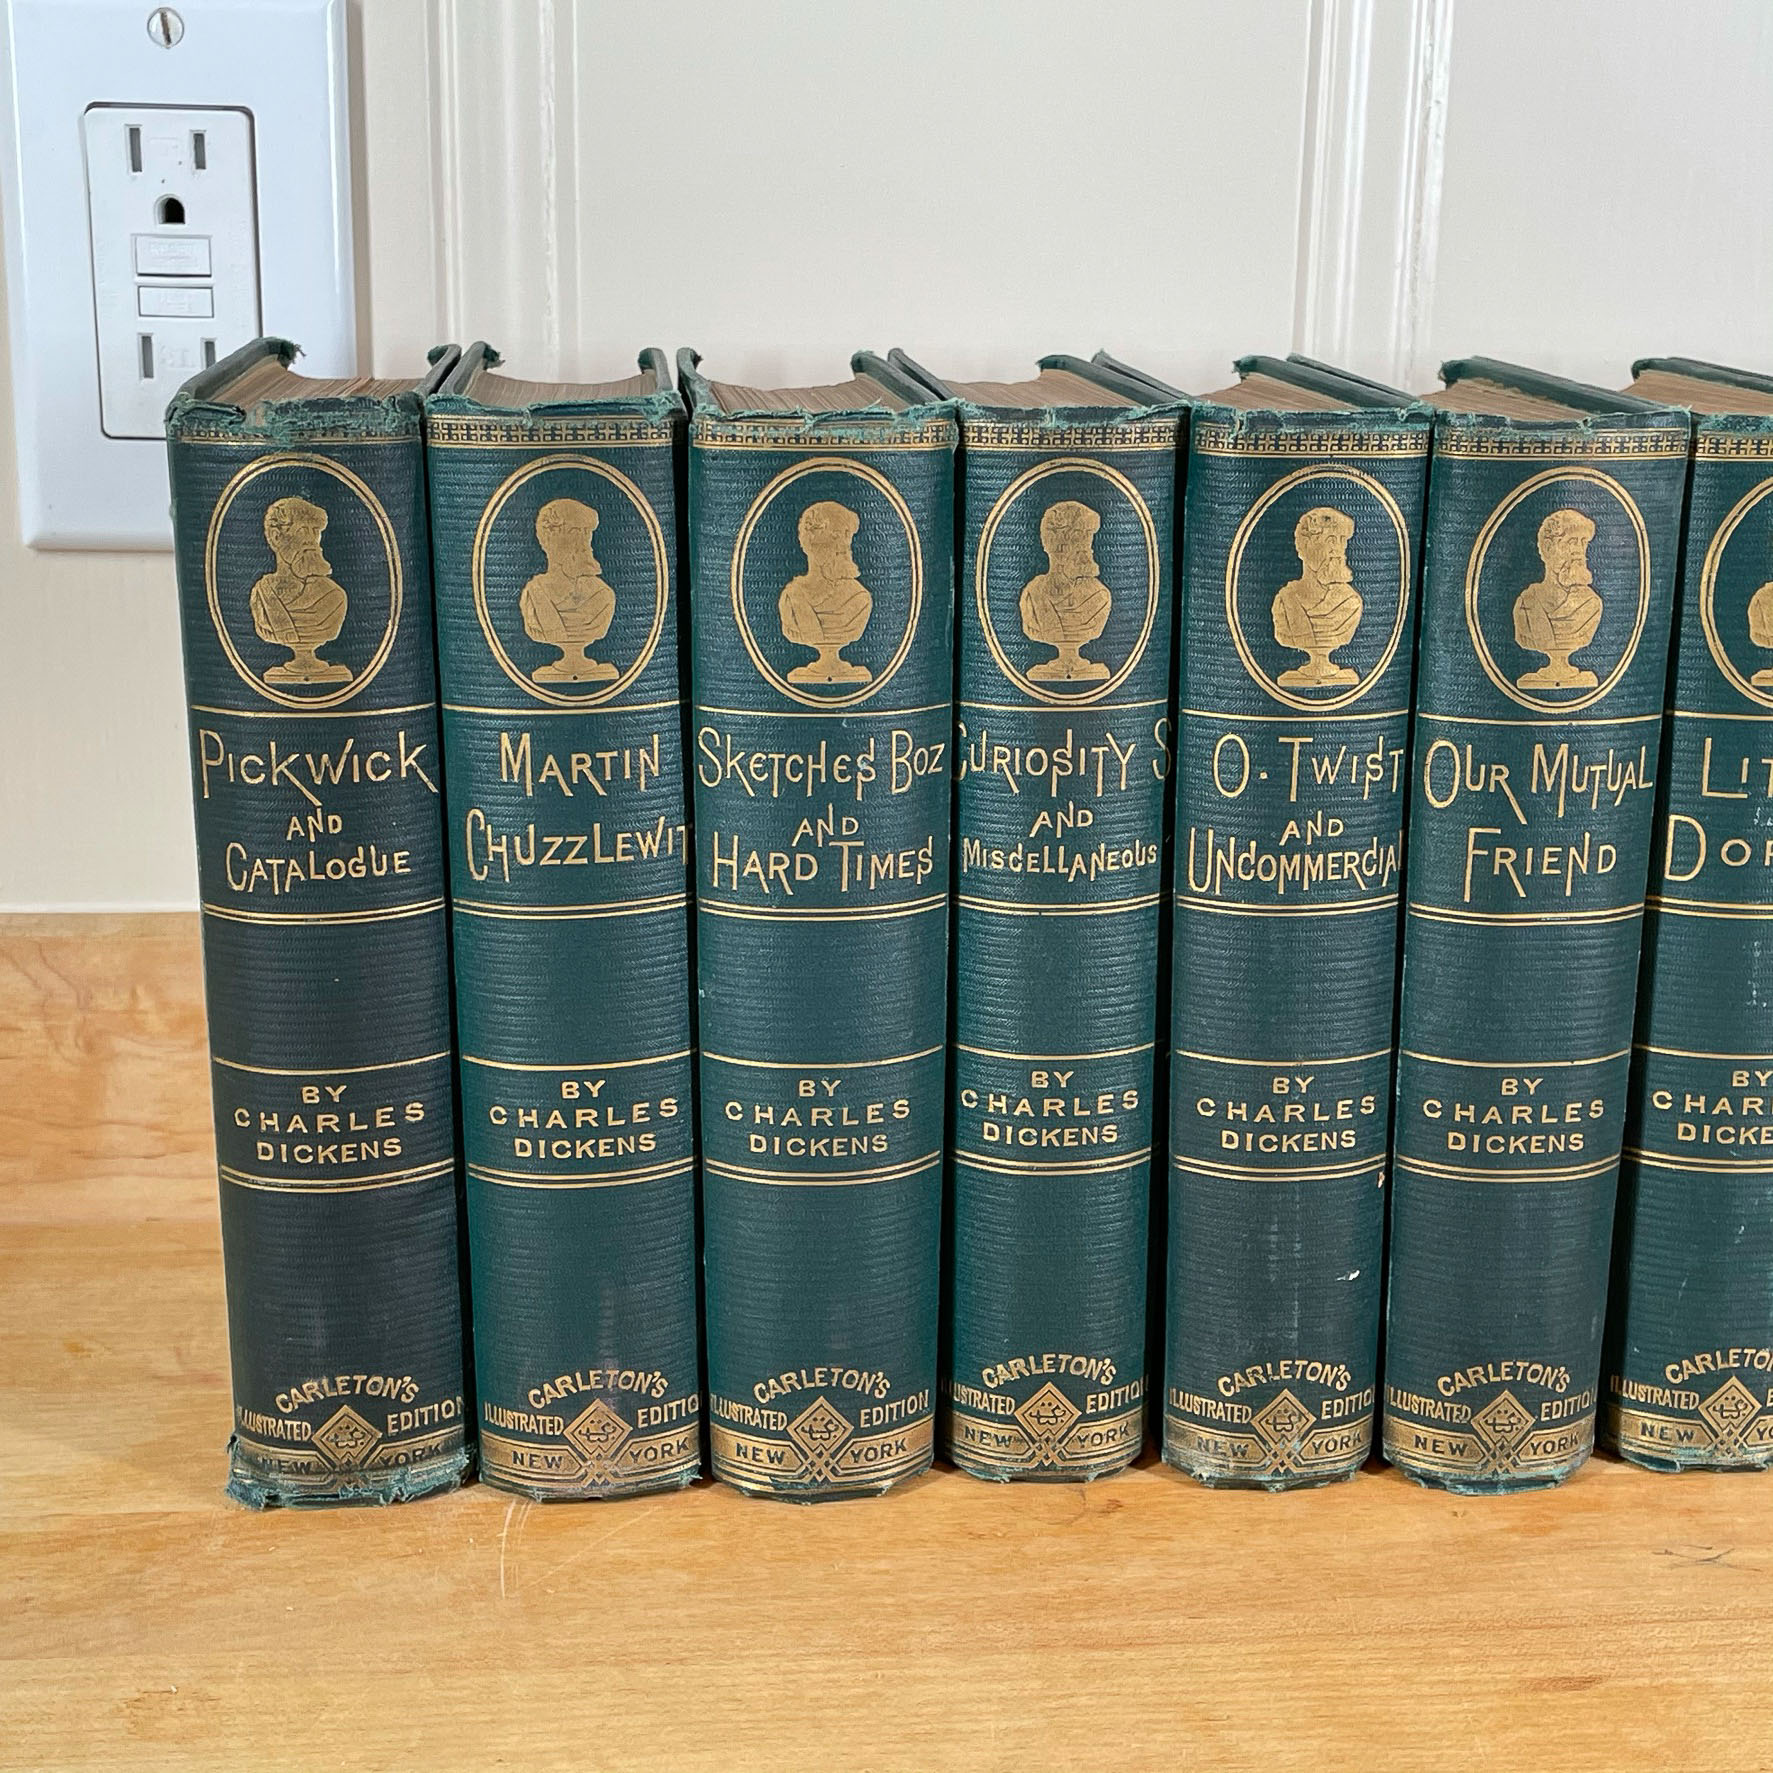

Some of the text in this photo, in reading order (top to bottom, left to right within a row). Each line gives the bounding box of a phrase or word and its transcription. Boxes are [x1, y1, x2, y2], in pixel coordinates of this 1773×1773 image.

[500, 732, 661, 799] MARTIN
[890, 729, 946, 795] BOZ
[1278, 735, 1405, 802] TWIST
[1423, 739, 1654, 824] OUR MUTUAL
[286, 808, 343, 844] AND
[791, 803, 860, 848] AND
[1029, 800, 1094, 838] AND
[1278, 811, 1345, 846] AND
[225, 842, 412, 895] CATALOGUE
[712, 832, 934, 896] HARD TIMES
[961, 838, 1158, 882] MISCELLANEOUS
[1463, 826, 1617, 903] FRIEND
[301, 1085, 348, 1104] BY
[560, 1079, 607, 1100] BY
[798, 1079, 843, 1098] BY
[1030, 1070, 1075, 1089] BY
[1272, 1075, 1315, 1096] BY
[1501, 1077, 1544, 1097] BY
[1732, 1069, 1773, 1087] BY
[233, 1101, 426, 1134] CHARLES
[488, 1097, 680, 1130] CHARLES
[725, 1100, 912, 1128] CHARLES
[960, 1089, 1140, 1118] CHARLES
[1196, 1095, 1378, 1124] CHARLES
[1422, 1098, 1606, 1126] CHARLES
[1651, 1090, 1773, 1116] CHAR
[514, 1133, 658, 1160] DICKENS
[749, 1133, 890, 1158] DICKENS
[982, 1121, 1119, 1147] DICKENS
[1220, 1129, 1358, 1153] DICKENS
[1446, 1130, 1585, 1155] DICKENS
[255, 1137, 403, 1165] DICKENS
[982, 1353, 1117, 1390] CARLETON'S
[1216, 1359, 1352, 1397] CARLETON'S
[1436, 1361, 1571, 1397] CARLETON'S
[1664, 1347, 1773, 1385] CARLETO
[275, 1374, 420, 1414] CARLETON'S
[528, 1369, 670, 1410] CARLETON'S
[753, 1366, 892, 1404] CARLETON'S
[483, 1401, 565, 1436] ILLUSTRATED
[859, 1389, 930, 1429] EDITION
[1168, 1387, 1252, 1424] ILLUSTRATED
[963, 1421, 1130, 1449] NEW YORK
[1196, 1428, 1363, 1458] NEW YORK
[1413, 1431, 1579, 1457] NEW YORK
[1640, 1420, 1695, 1442] NEW
[511, 1436, 690, 1470] NEW YORK
[735, 1437, 908, 1465] NEW YORK
